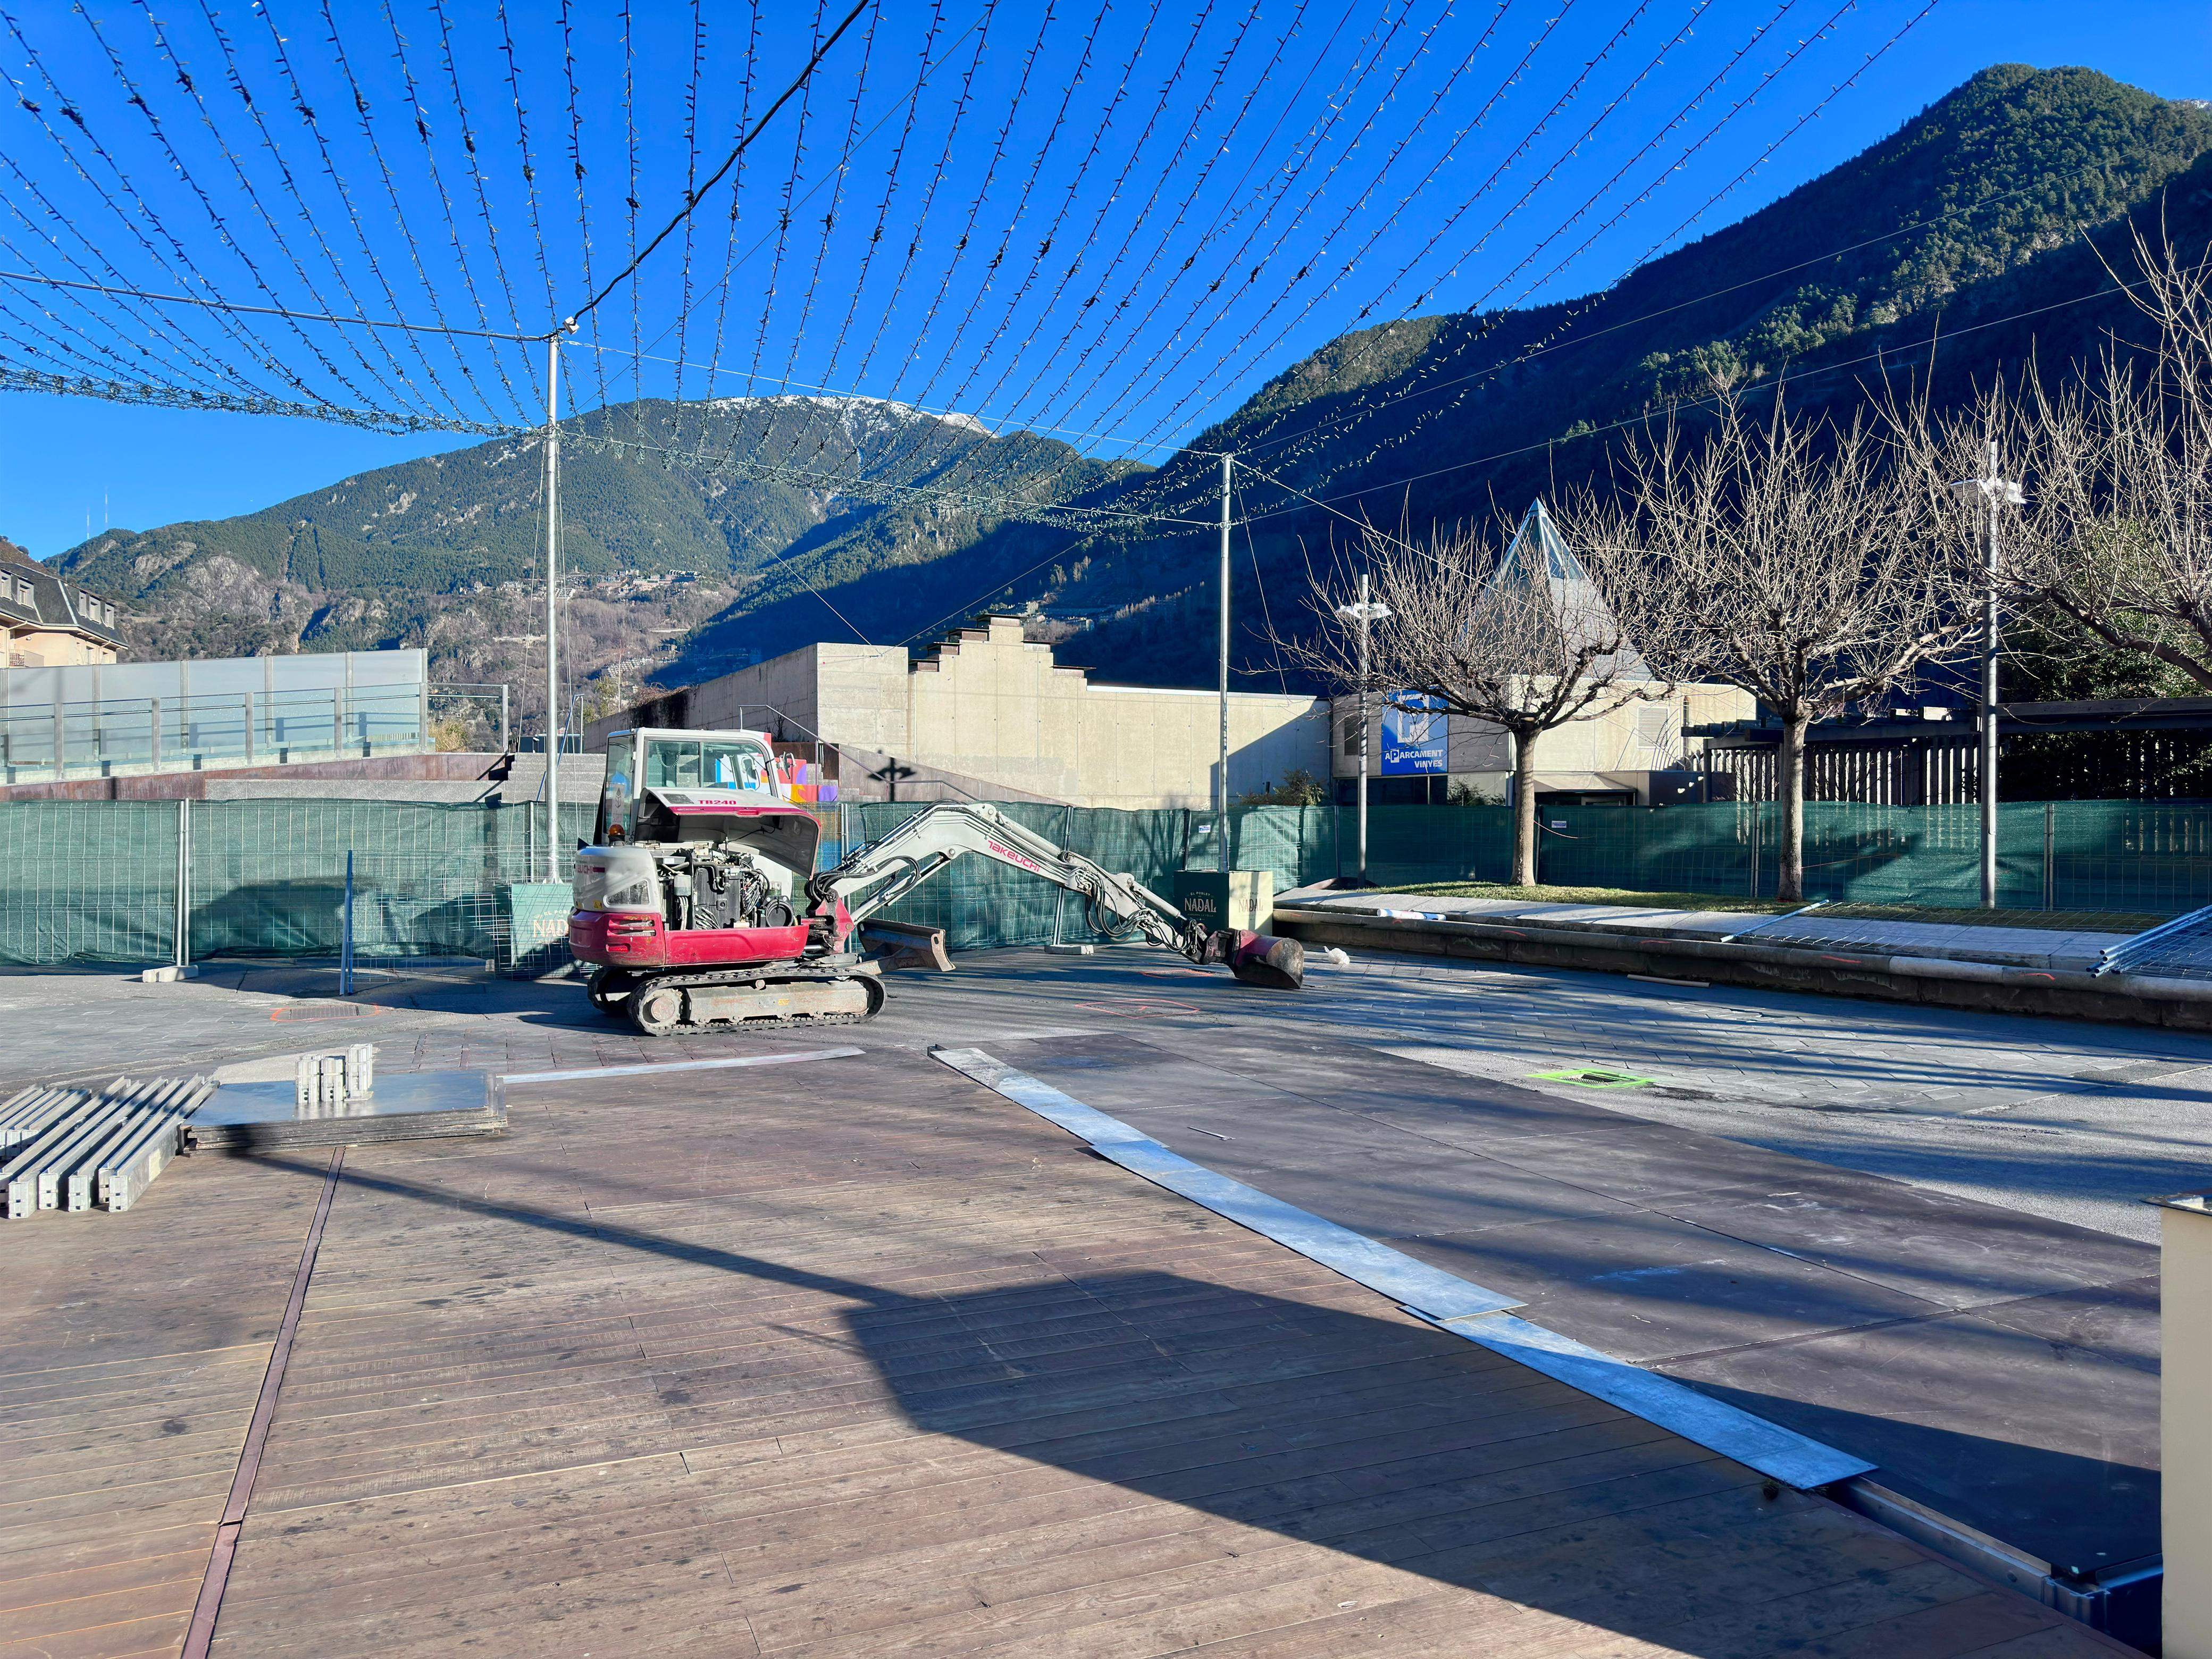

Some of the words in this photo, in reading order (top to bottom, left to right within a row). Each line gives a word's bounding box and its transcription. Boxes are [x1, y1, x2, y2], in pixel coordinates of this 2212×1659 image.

[1385, 749, 1443, 763] APARCAMENT
[1414, 760, 1443, 768] VINYES
[1185, 898, 1217, 912] NADAL
[1238, 898, 1263, 912] NADAL
[533, 919, 569, 937] NAD
